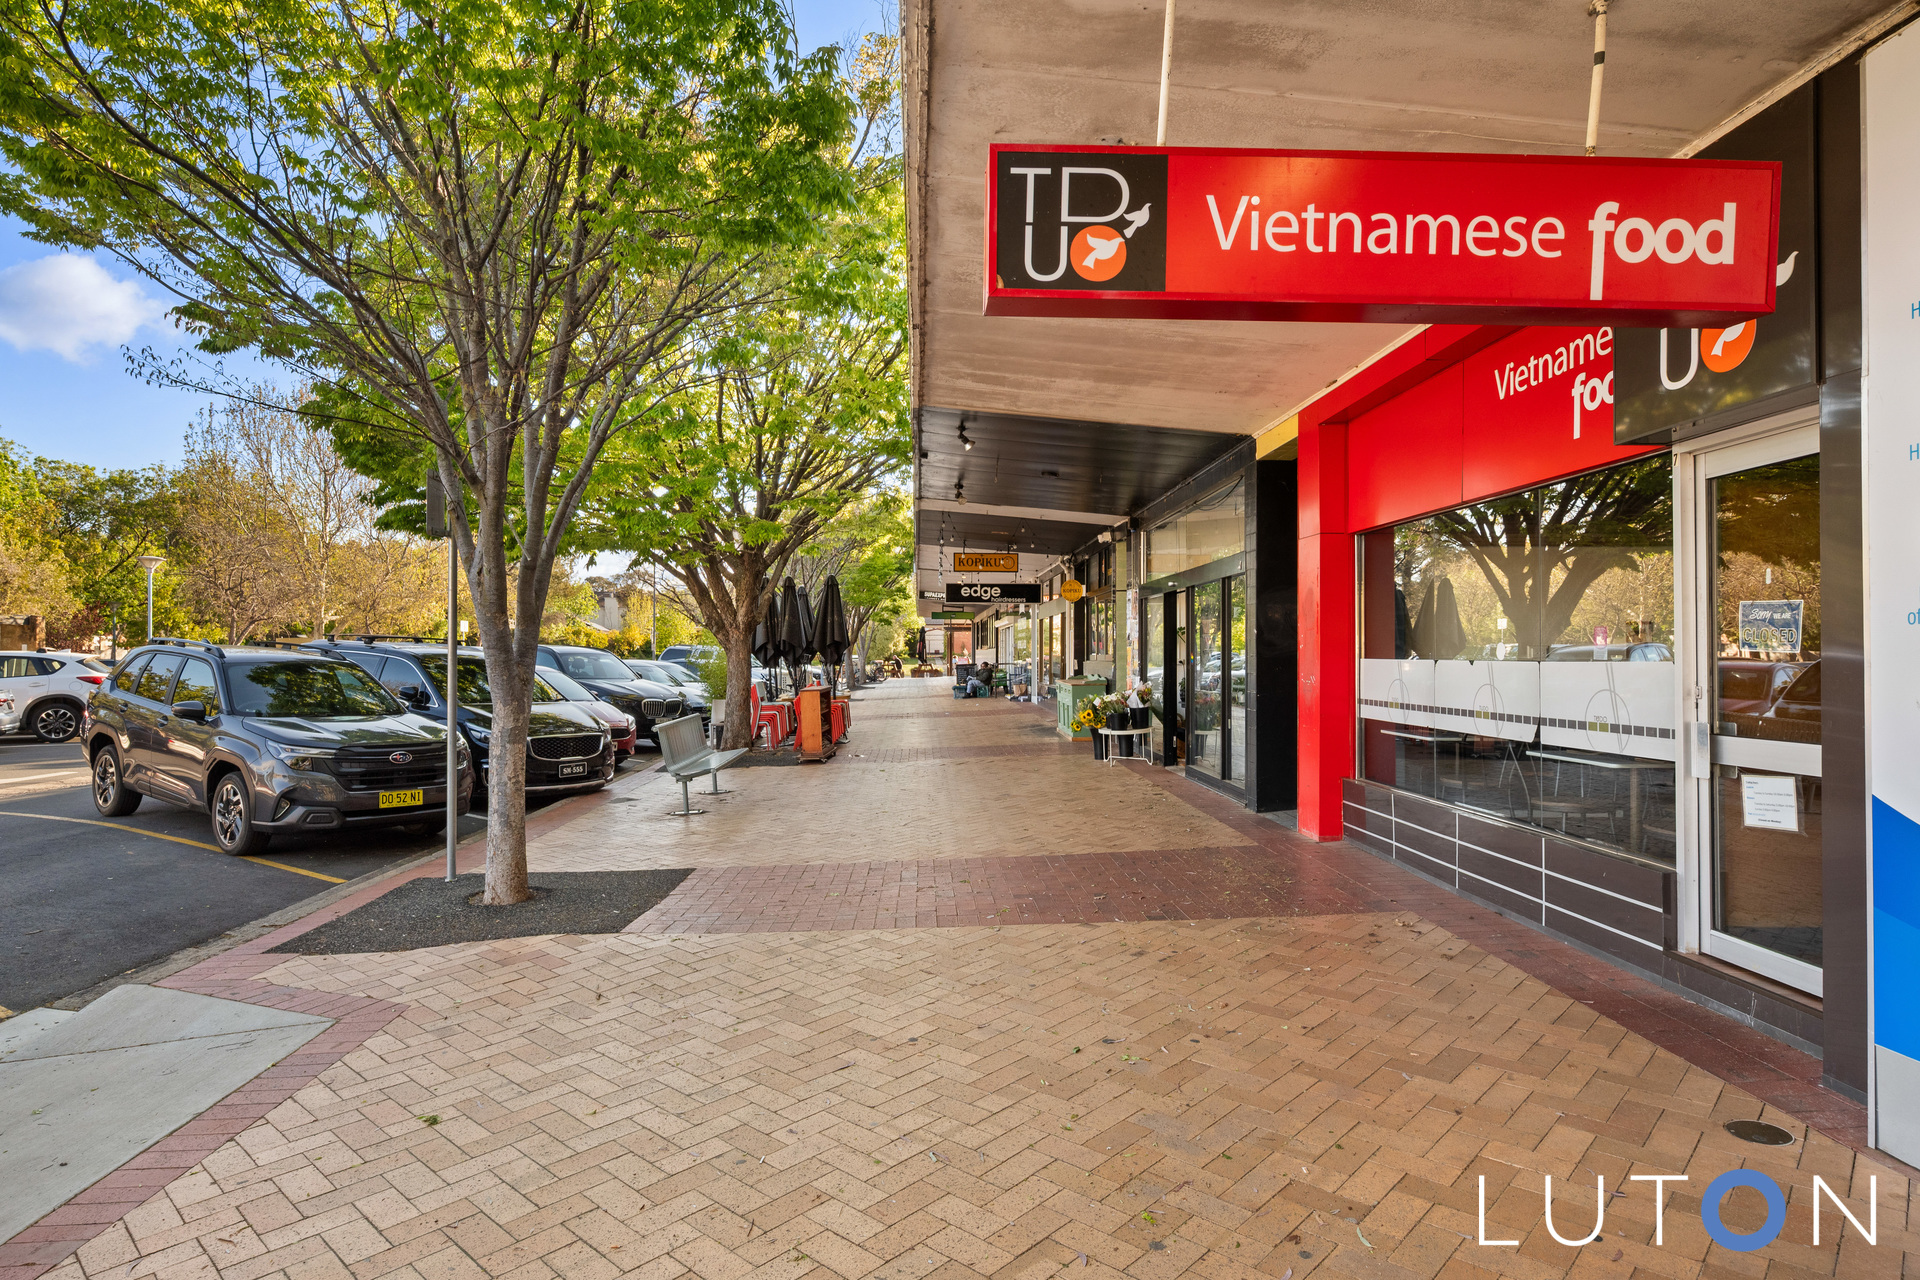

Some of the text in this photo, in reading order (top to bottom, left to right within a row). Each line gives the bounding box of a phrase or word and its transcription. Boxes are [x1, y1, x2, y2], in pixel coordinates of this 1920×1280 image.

[1206, 194, 1737, 301] Vietnamese food
[1494, 326, 1613, 400] Vietname
[1571, 370, 1614, 440] foo
[958, 557, 1004, 568] KOPIKU
[960, 584, 1001, 600] edge
[1749, 608, 1772, 623] Sorry
[1743, 627, 1798, 644] CLOSED
